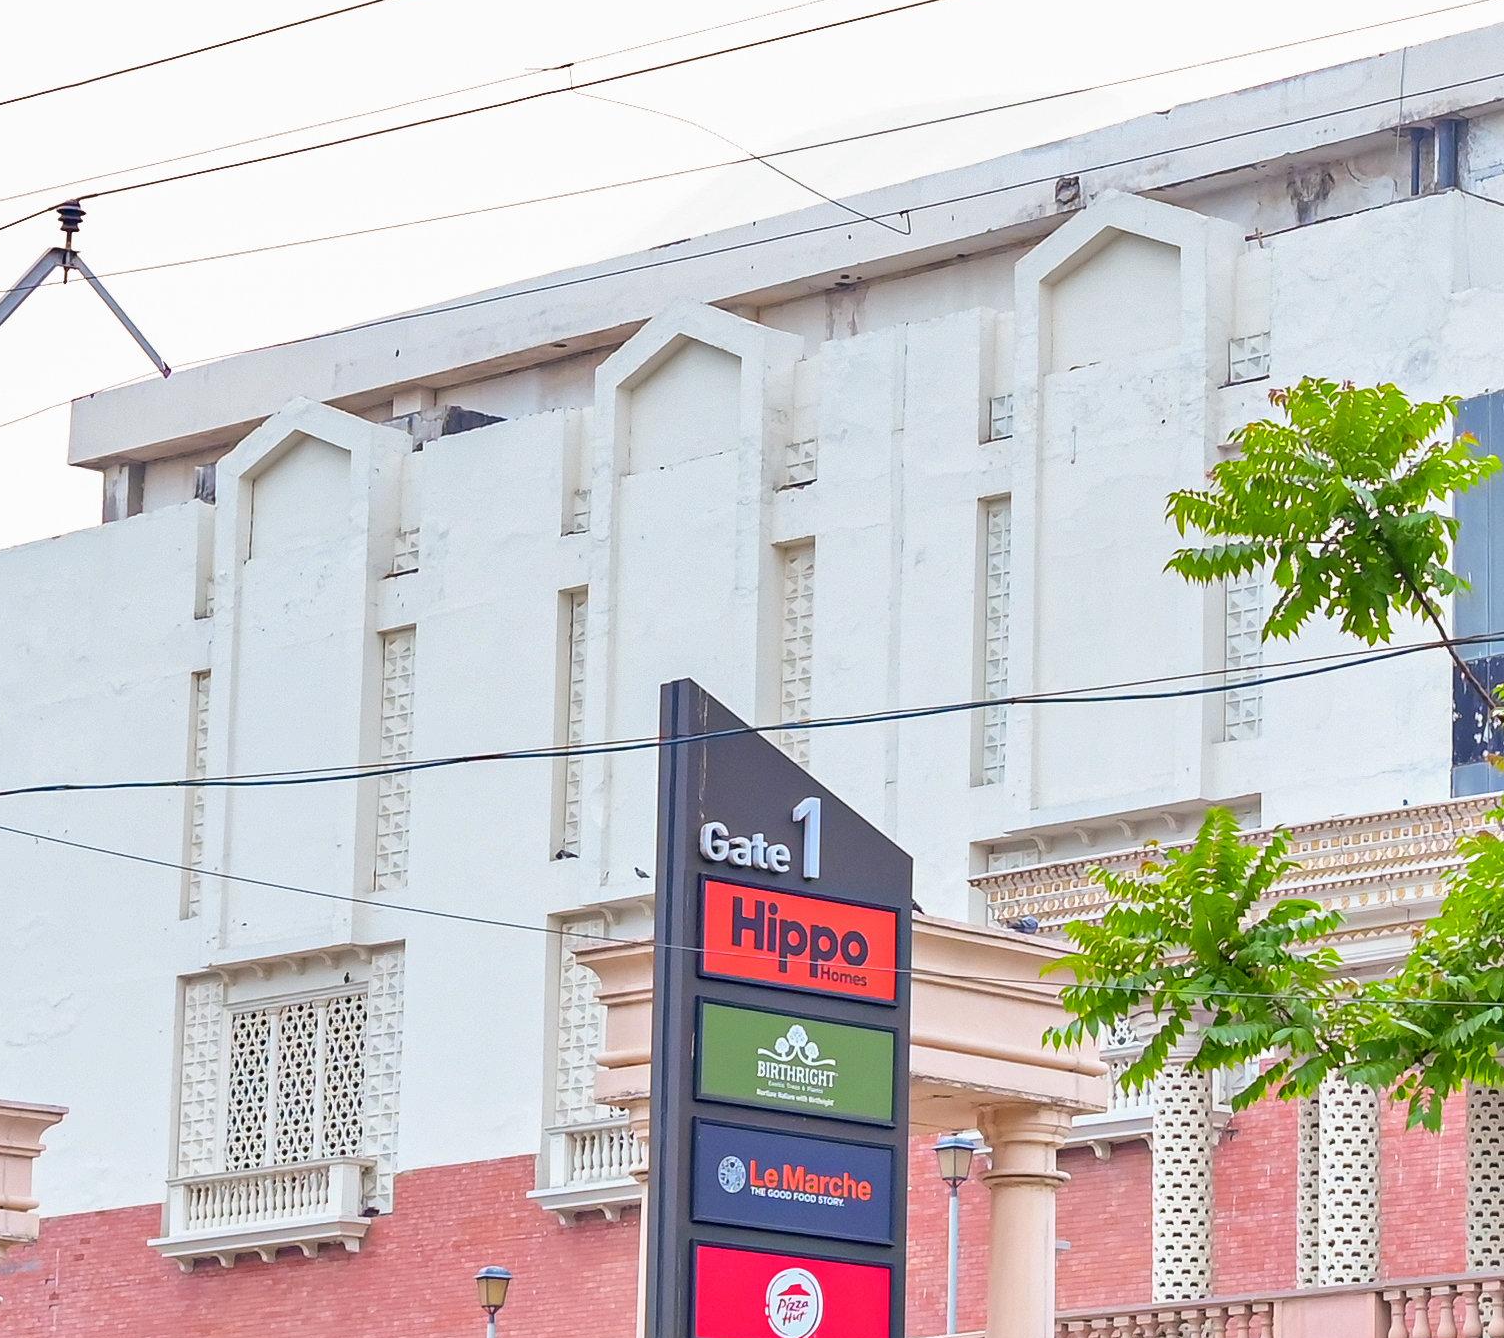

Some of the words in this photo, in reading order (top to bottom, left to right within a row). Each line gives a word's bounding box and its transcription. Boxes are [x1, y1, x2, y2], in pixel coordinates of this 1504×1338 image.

[698, 821, 791, 875] Gate
[791, 796, 822, 880] 1
[731, 895, 869, 979] Hippo
[819, 965, 868, 987] Homes
[756, 1060, 835, 1088] BIRTHRIGHT
[749, 1159, 779, 1188] Le
[782, 1163, 872, 1201] Marche
[750, 1185, 766, 1197] THE
[767, 1188, 792, 1200] GOOD
[793, 1192, 817, 1203] FOOD
[776, 1297, 809, 1315] Pizza
[782, 1311, 806, 1326] Hut
